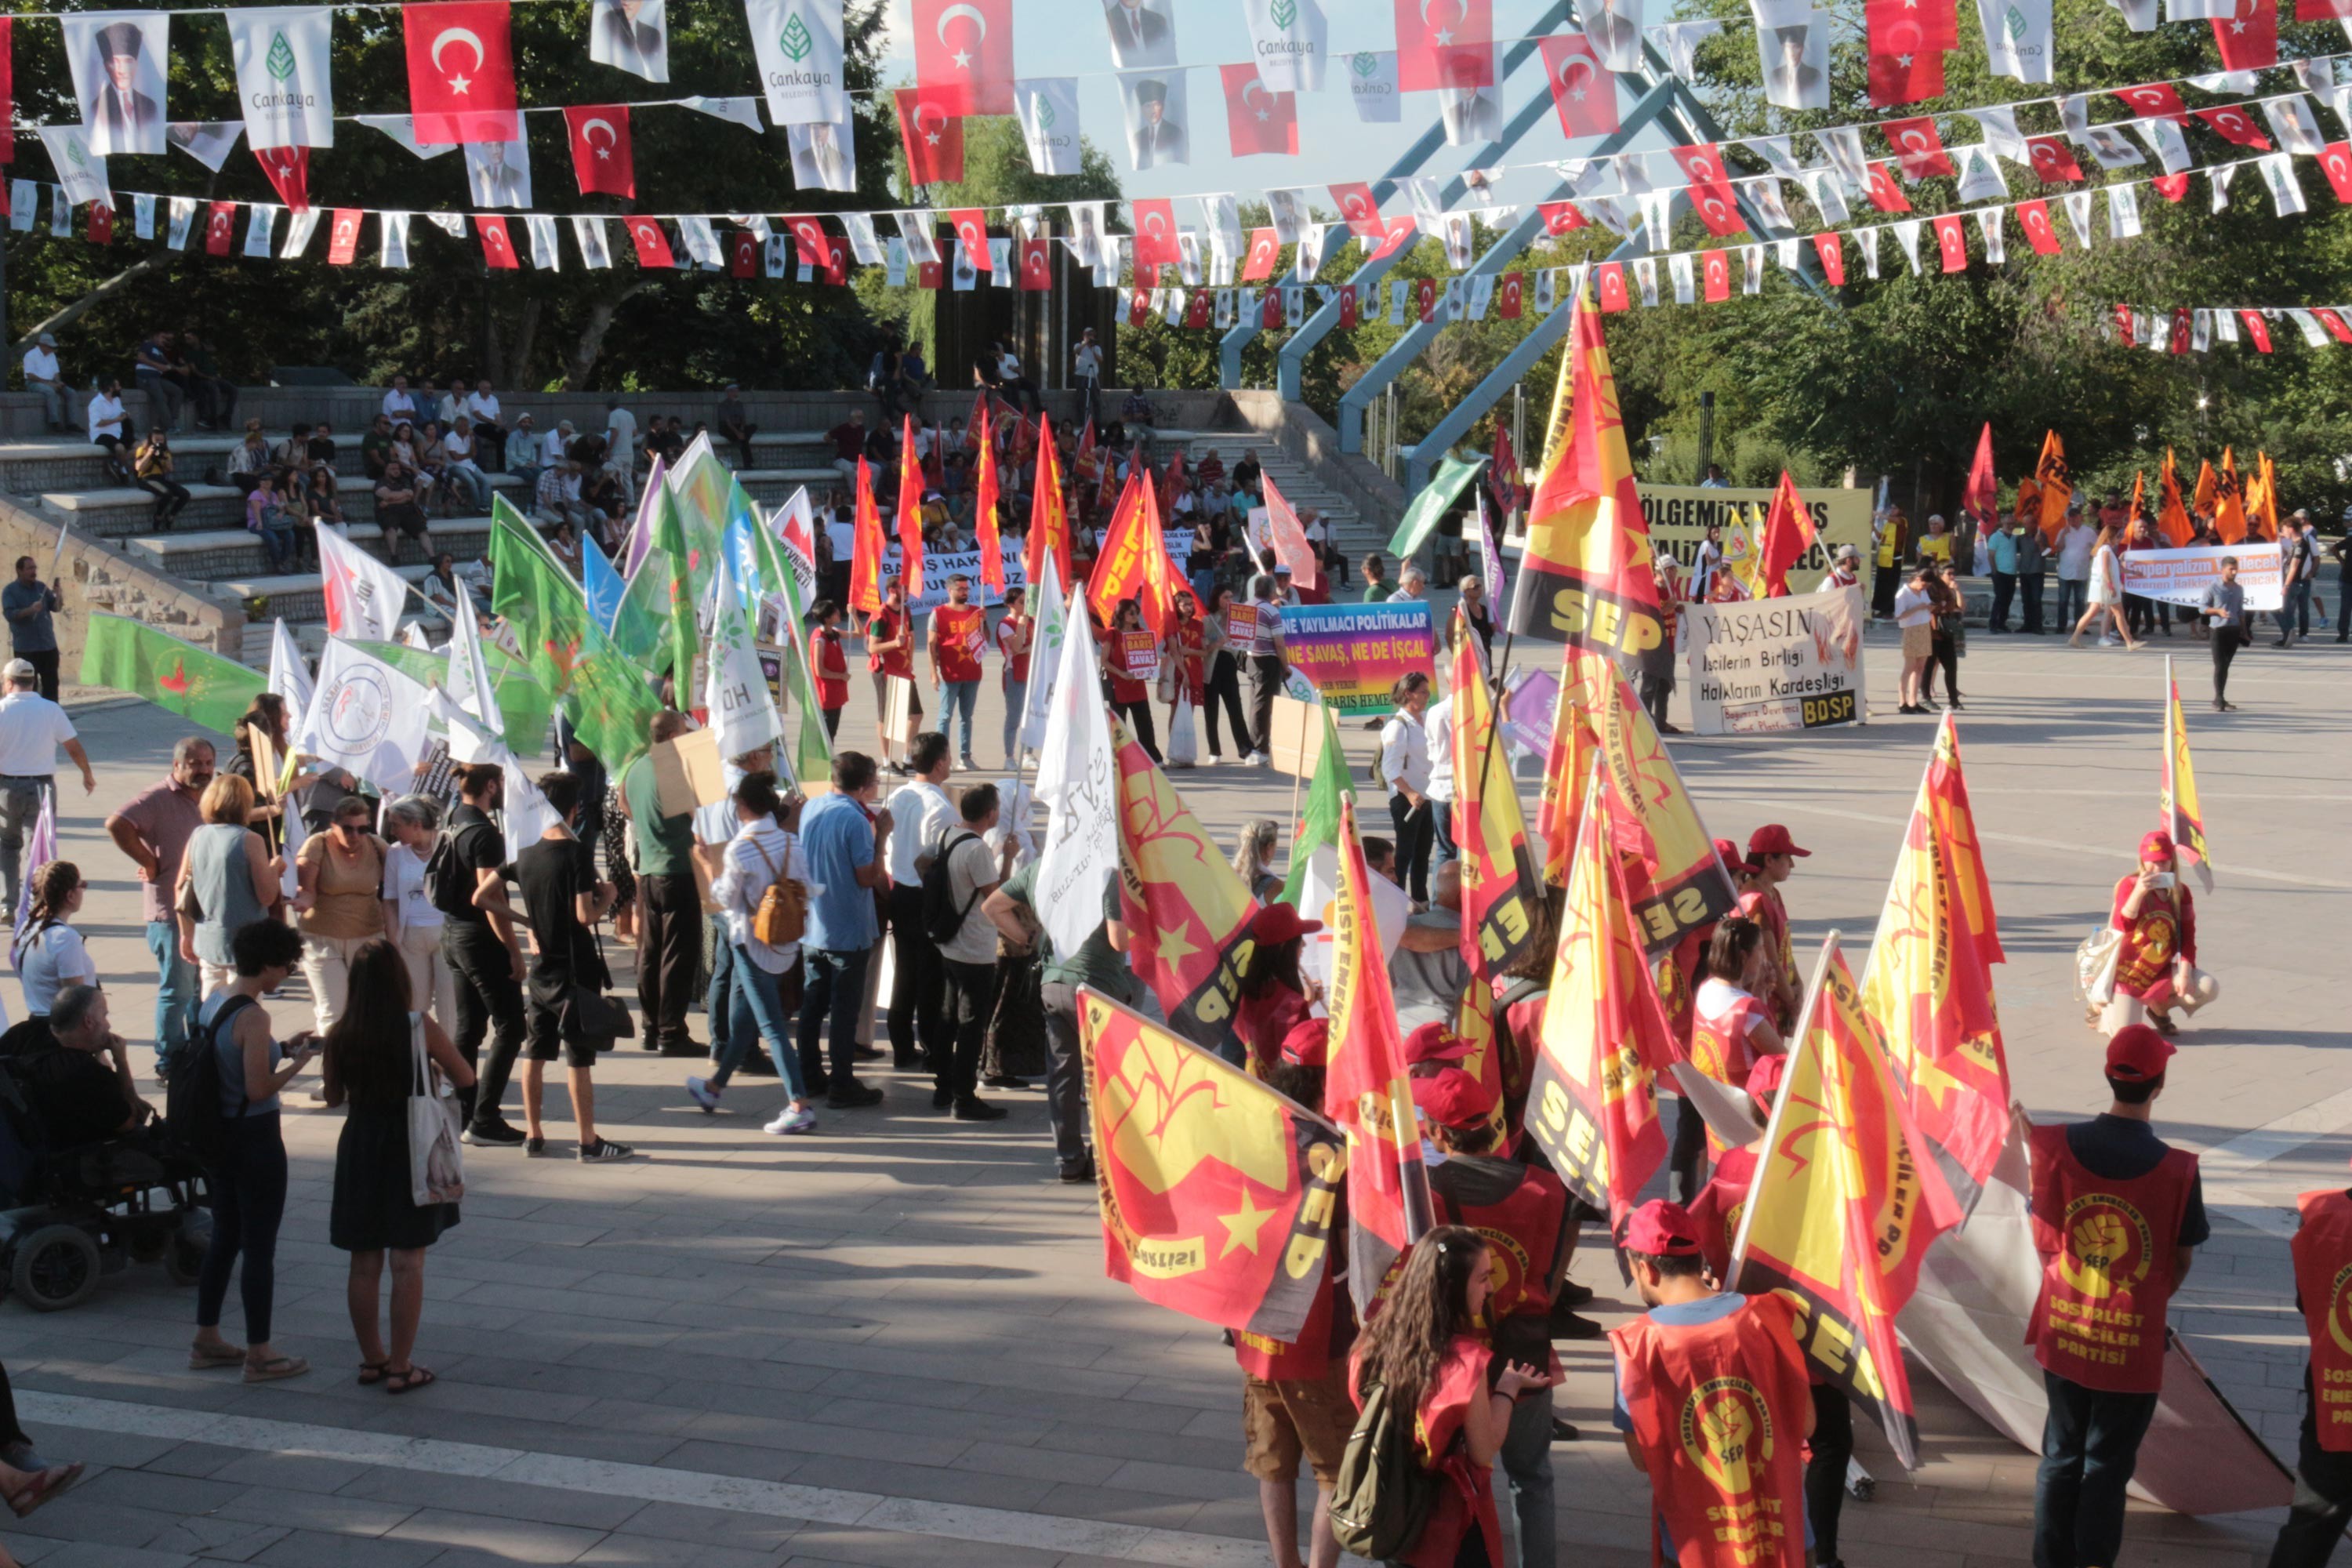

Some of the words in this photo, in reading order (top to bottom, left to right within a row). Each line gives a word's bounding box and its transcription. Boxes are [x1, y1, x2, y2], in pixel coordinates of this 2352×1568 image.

[1258, 38, 1314, 56] Çankaya
[769, 69, 831, 88] Çankaya
[252, 92, 315, 110] Çankaya
[883, 557, 938, 574] BAIŞ
[942, 551, 1017, 570] HAKNI
[2215, 554, 2278, 571] Yilecek
[1282, 618, 1297, 633] NE
[1300, 615, 1355, 633] YAYILMACI
[1357, 609, 1427, 630] POLİTİKALAR
[1551, 589, 1662, 656] SEP
[1703, 608, 1814, 646] YAŞASIN
[1286, 645, 1305, 664] NE
[1306, 643, 1350, 666] SAVAŞ,
[1352, 642, 1370, 661] NE
[1372, 641, 1390, 660] DE
[1392, 636, 1427, 664] İŞGAL
[1761, 649, 1803, 667] Birliği
[1701, 681, 1762, 701] Halkların
[1770, 670, 1844, 696] Kardeşliği
[1804, 696, 1853, 724] BDSP
[2084, 1254, 2110, 1269] SEP
[2050, 1294, 2145, 1328] SOSYALİST
[2058, 1338, 2126, 1366] PARTİSİ
[1721, 1443, 1744, 1465] SEP
